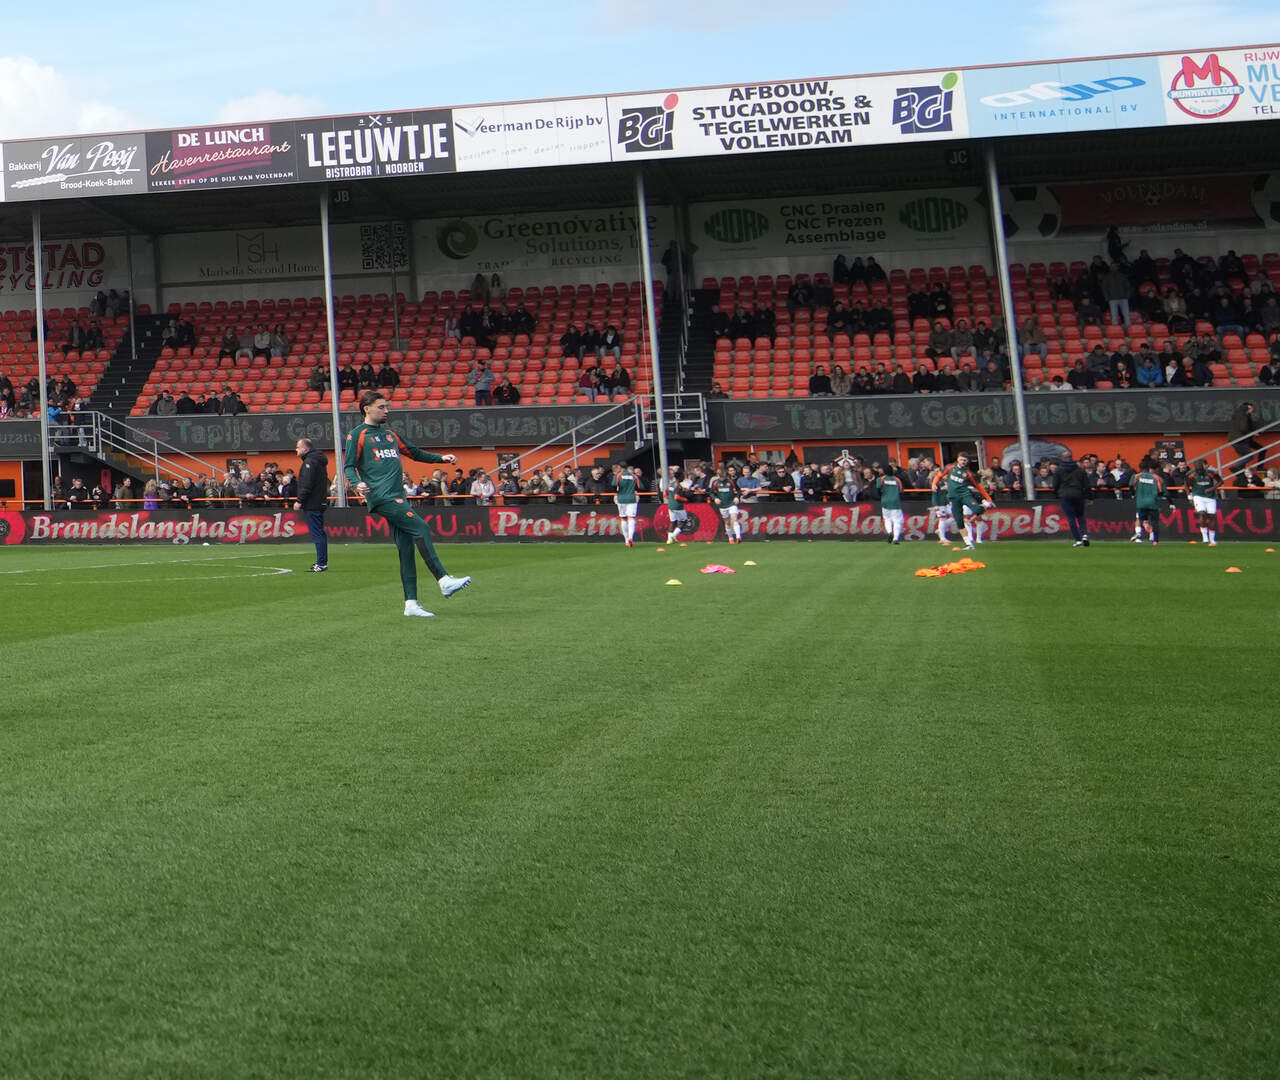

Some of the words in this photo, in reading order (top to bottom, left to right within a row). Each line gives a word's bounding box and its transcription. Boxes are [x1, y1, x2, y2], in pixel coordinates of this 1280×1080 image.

[728, 81, 834, 102] AFBOUW,
[692, 96, 846, 122] STUCADOORS
[853, 94, 873, 109] &
[994, 106, 1112, 121] INTERNATIONAL
[1121, 103, 1139, 112] BV
[535, 117, 554, 130] De
[556, 116, 584, 132] Rijp
[586, 114, 604, 127] bv
[699, 111, 871, 137] TEGELWERKEN
[178, 133, 200, 148] DE
[205, 127, 265, 146] LUNCH
[307, 123, 449, 168] LEEUWTJE
[719, 129, 853, 151] VOLENDAM
[42, 143, 81, 175] Van
[150, 141, 291, 176] Havenrestaurant
[151, 179, 176, 187] LEKKER
[178, 178, 197, 186] ETEN
[221, 176, 237, 184] DIJK
[239, 174, 254, 182] VAN
[255, 171, 294, 180] VOLENDAM
[326, 164, 372, 179] BISTROBAR
[385, 161, 425, 174] NOORDEN
[60, 177, 134, 190] Brood-Koek-Banket
[334, 190, 350, 203] JB
[779, 204, 816, 218] CNC
[821, 200, 886, 215] Draaien
[785, 217, 821, 231] CNC
[826, 215, 883, 229] Frezen
[526, 234, 624, 255] Solutions,
[784, 228, 887, 245] Assemblage
[785, 402, 880, 436] Tapijt
[887, 401, 914, 429] &
[259, 420, 281, 443] &
[375, 448, 399, 459] HSB
[30, 513, 296, 545] Brandslanghaspels
